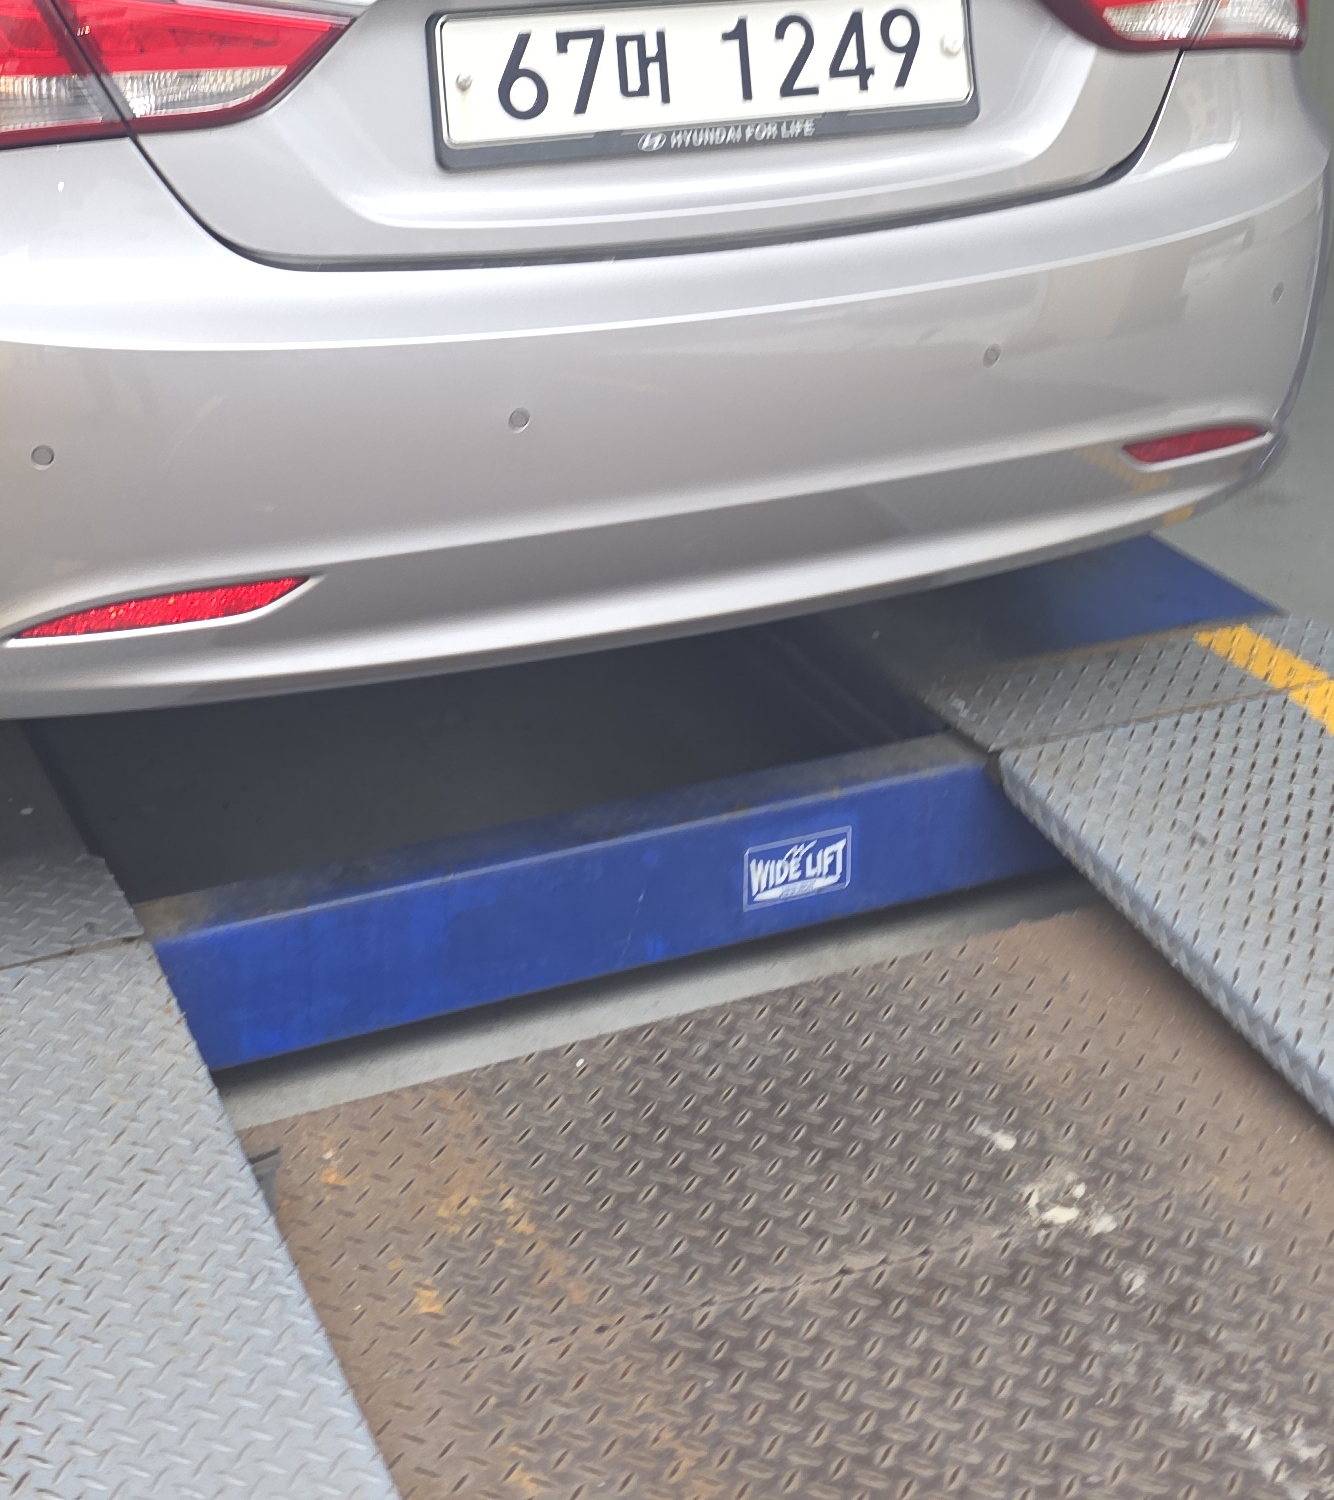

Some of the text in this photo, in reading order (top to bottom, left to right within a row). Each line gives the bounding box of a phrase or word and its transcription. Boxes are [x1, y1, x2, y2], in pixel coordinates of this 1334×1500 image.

[497, 7, 922, 120] 67머 1249
[670, 117, 816, 149] HYUNDAI FOR LIFE
[749, 850, 802, 897] WIDE
[805, 838, 847, 878] LIFT
